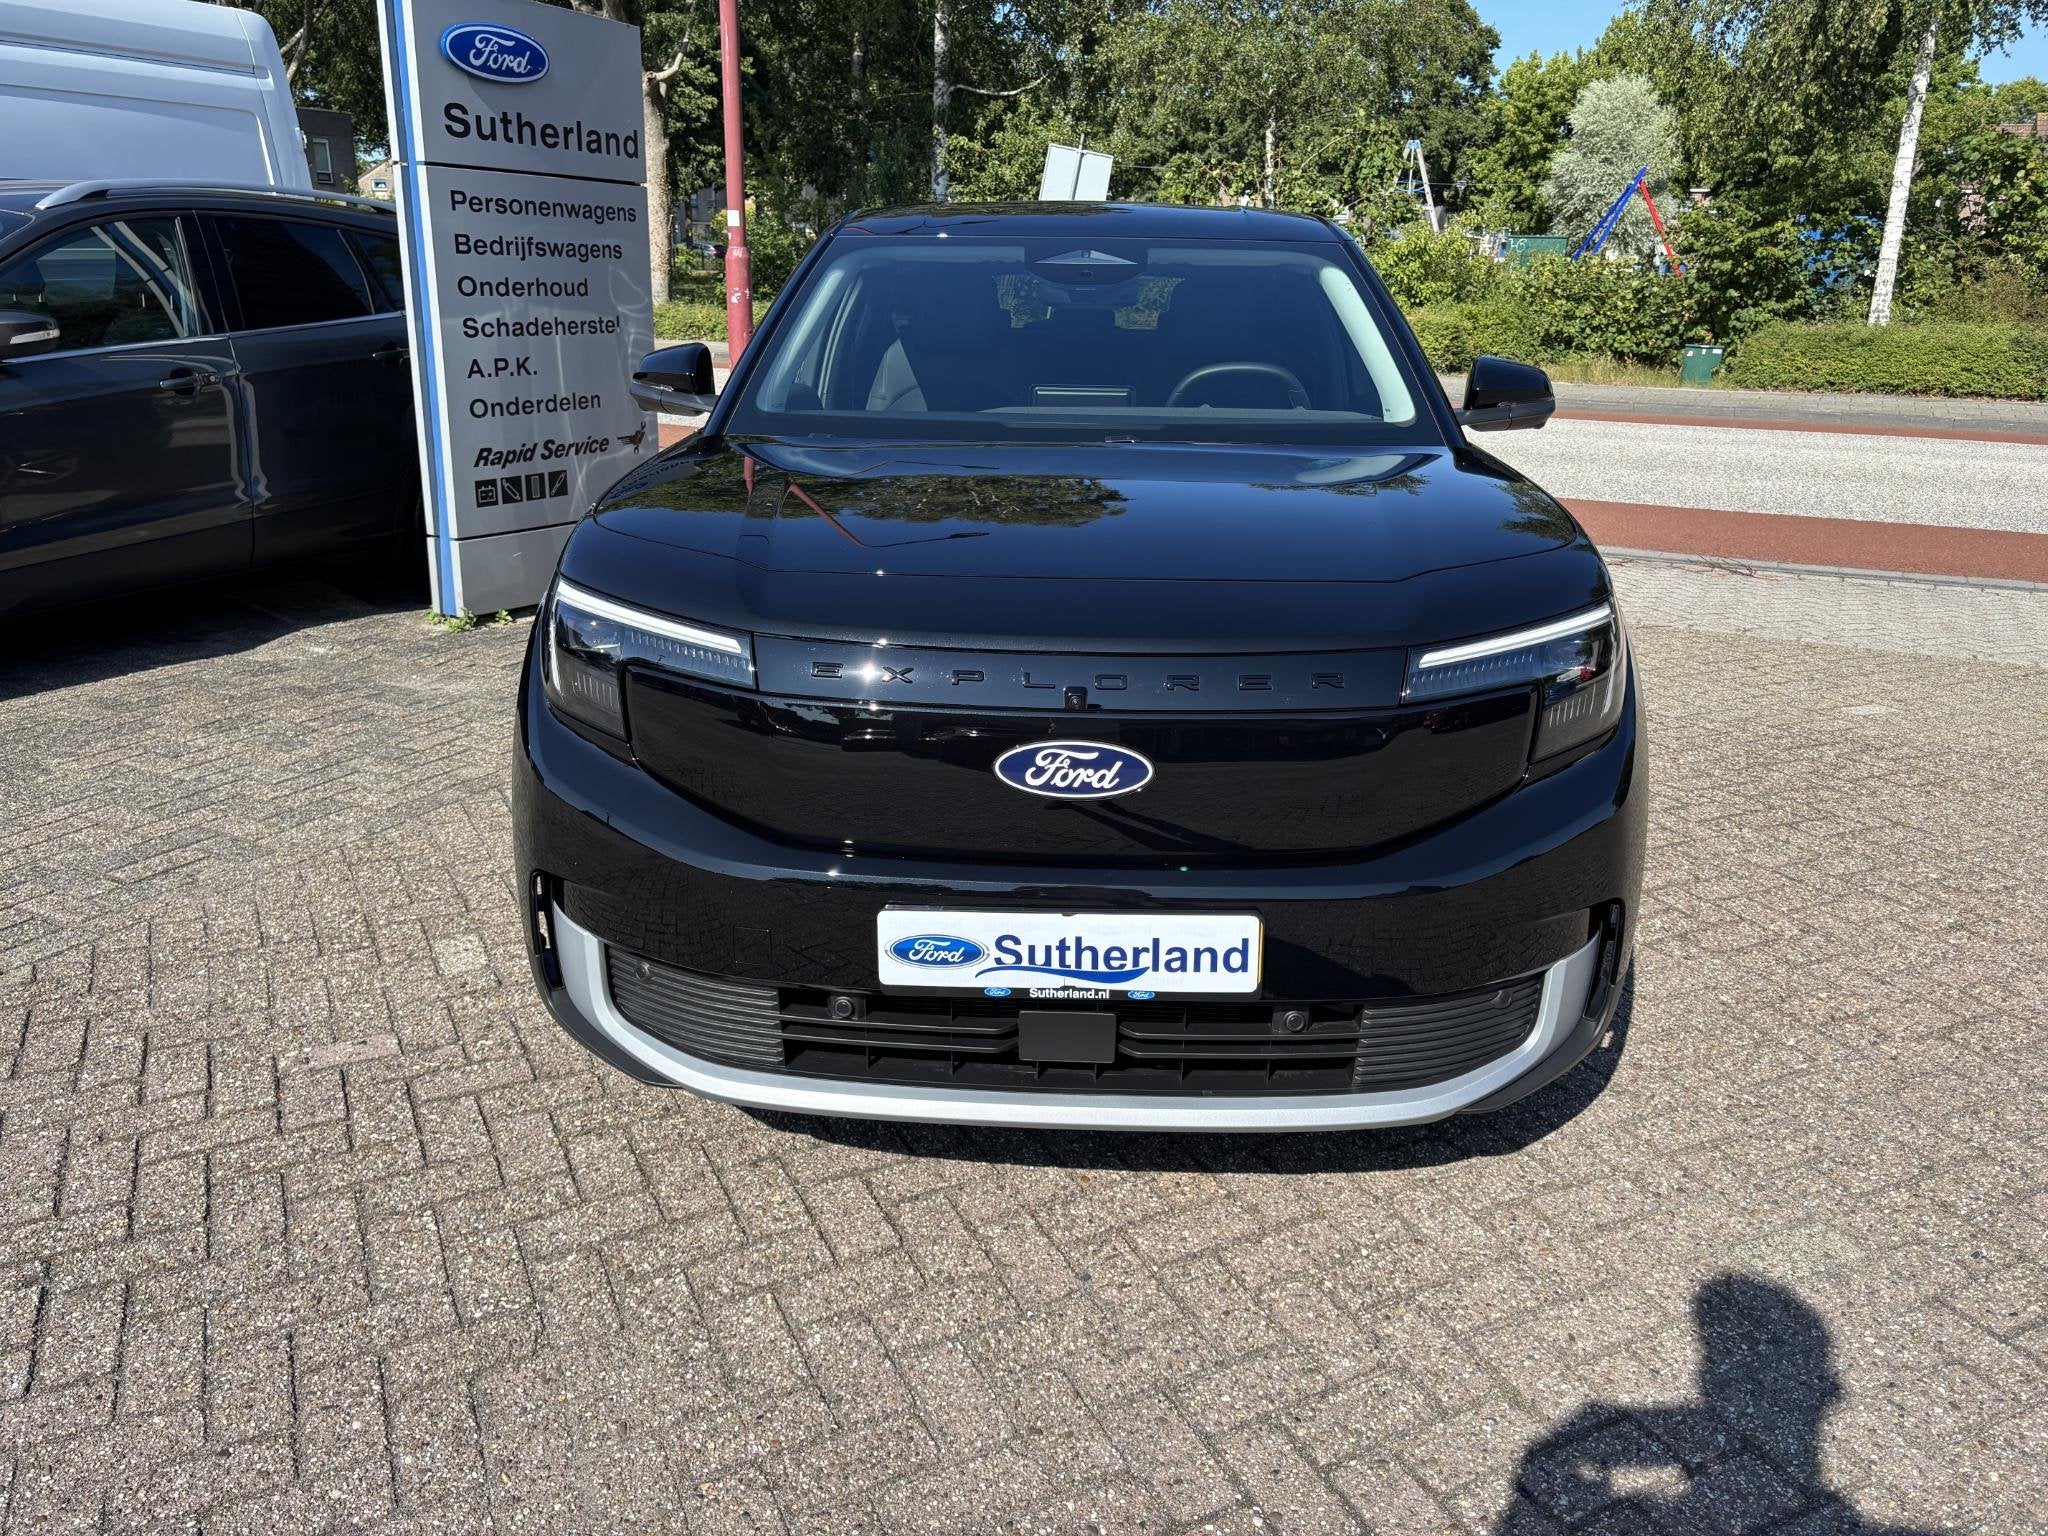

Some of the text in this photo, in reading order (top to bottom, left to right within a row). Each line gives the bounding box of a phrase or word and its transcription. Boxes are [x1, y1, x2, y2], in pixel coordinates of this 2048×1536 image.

[469, 34, 531, 74] Ford
[444, 102, 639, 160] Sutherland
[450, 190, 637, 224] Personenwagens
[454, 234, 623, 263] Bedrijfswagens
[457, 275, 589, 298] Onderhoud
[467, 356, 538, 379] A.P.K.
[469, 392, 602, 419] Onderdelen
[473, 436, 610, 469] Rapid Service
[811, 660, 1345, 692] EXPLORER
[1024, 748, 1120, 789] Ford
[908, 934, 1250, 974] Ford Sutherland
[1029, 988, 1109, 999] Sutherland.nl
